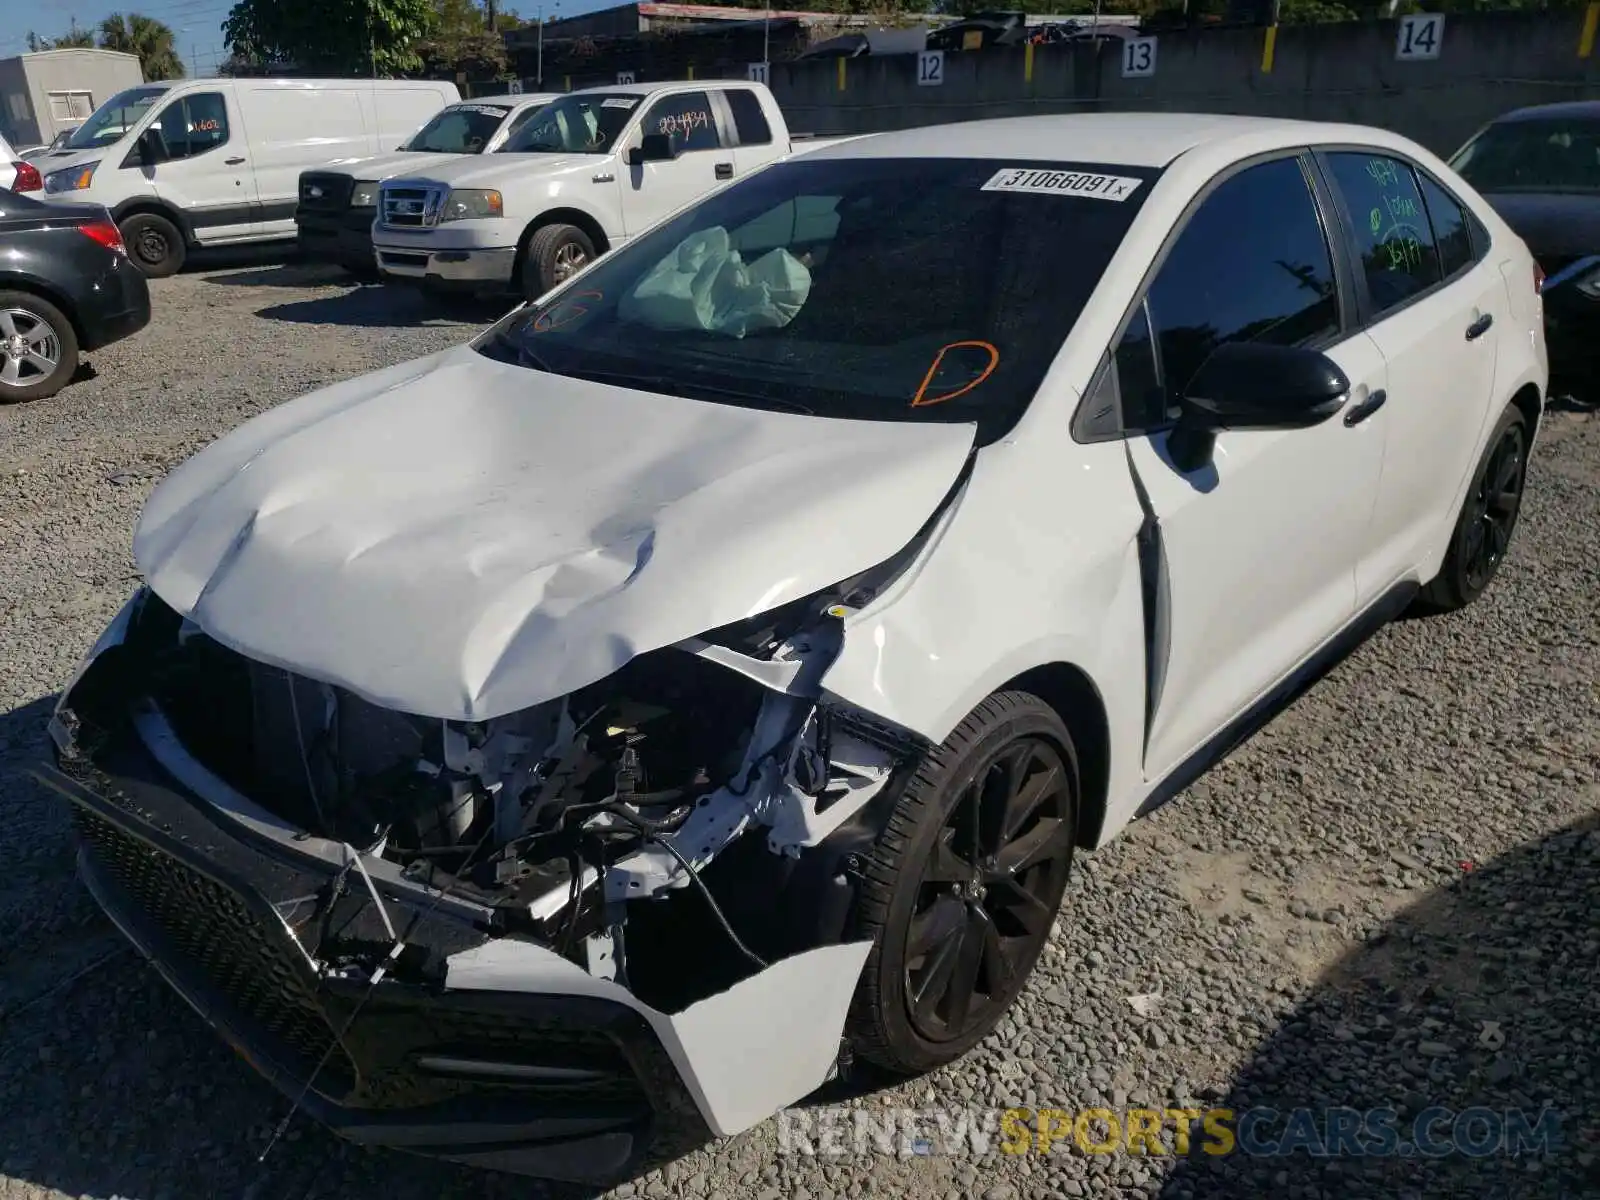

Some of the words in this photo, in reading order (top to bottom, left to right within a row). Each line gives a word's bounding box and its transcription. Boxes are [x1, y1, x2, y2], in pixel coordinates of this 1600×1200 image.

[1402, 21, 1436, 53] 14
[921, 56, 940, 81] 12
[1126, 42, 1150, 71] 13
[1005, 170, 1119, 193] 31066091
[912, 340, 1000, 408] D
